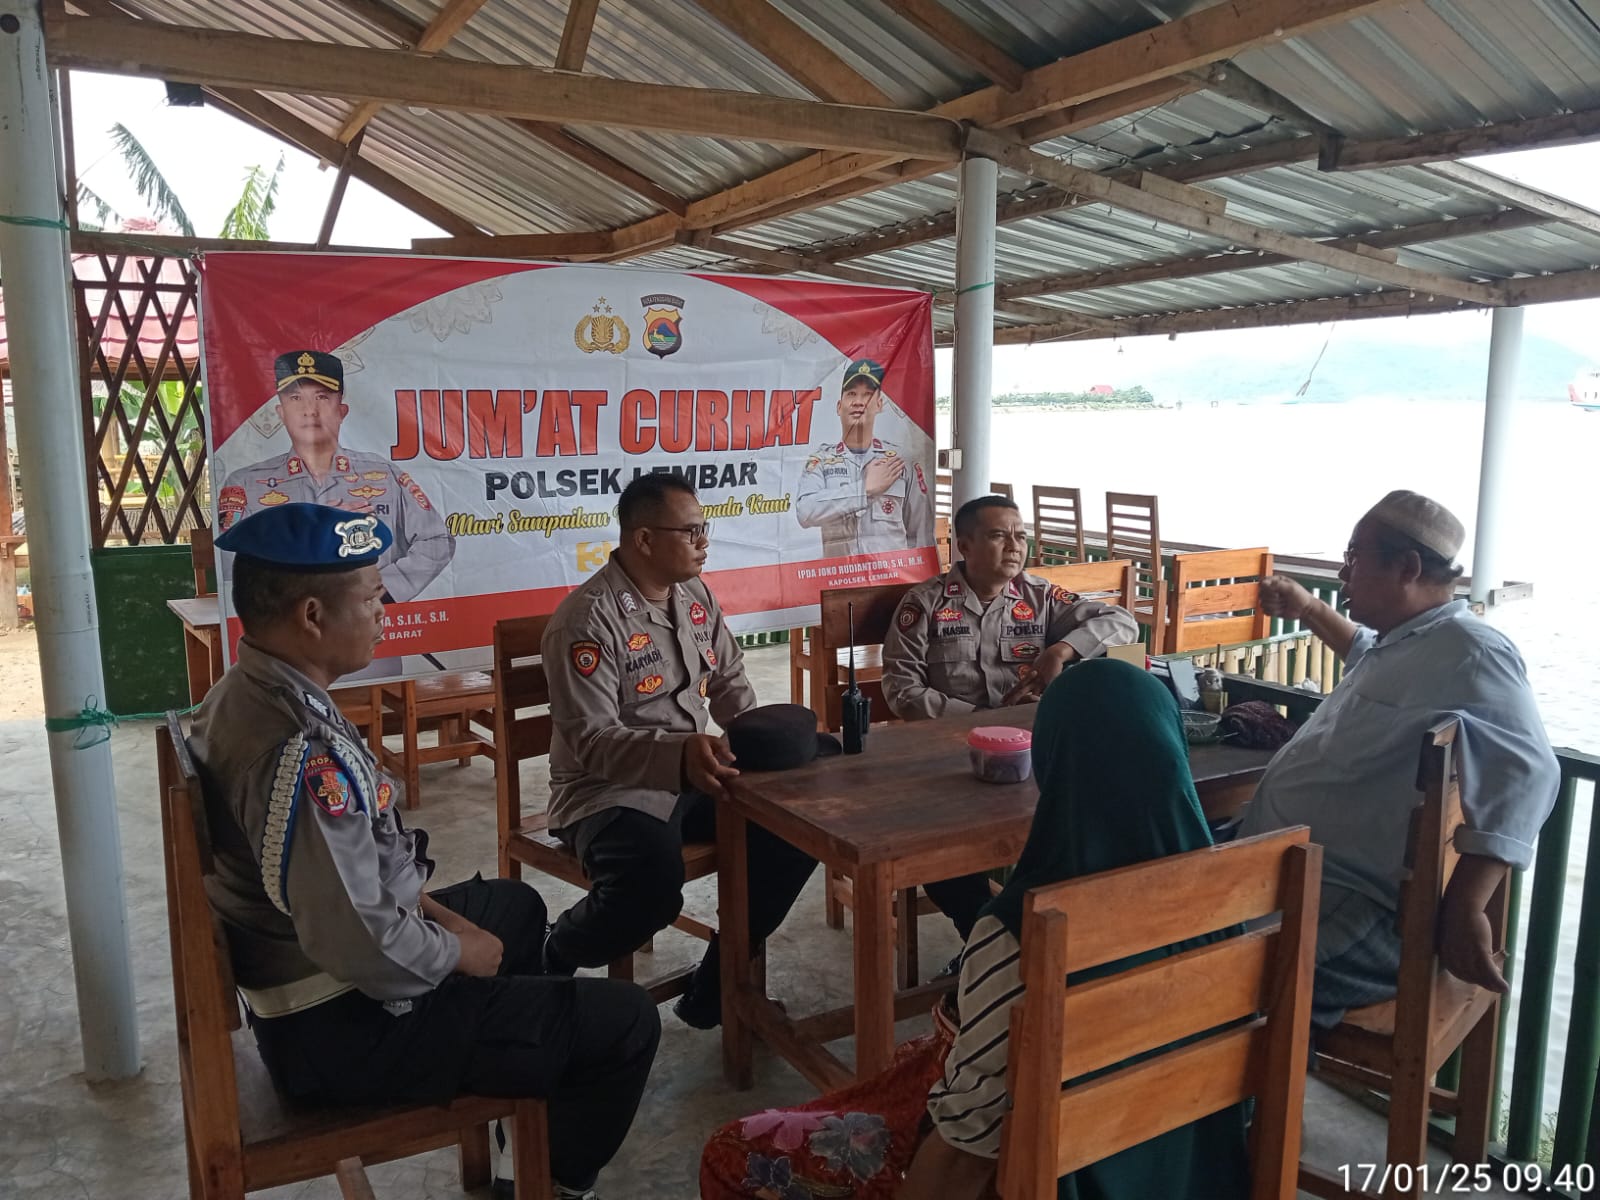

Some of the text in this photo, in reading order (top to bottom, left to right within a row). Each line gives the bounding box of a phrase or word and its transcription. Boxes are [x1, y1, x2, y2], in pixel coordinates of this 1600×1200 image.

[390, 387, 822, 461] JUM'AT CURHAT
[485, 468, 621, 500] POLSEK
[446, 513, 504, 537] Mari
[508, 506, 610, 538] Sampaikan
[746, 493, 791, 515] Kami
[429, 610, 449, 623] S.H.
[389, 630, 423, 640] BARAT
